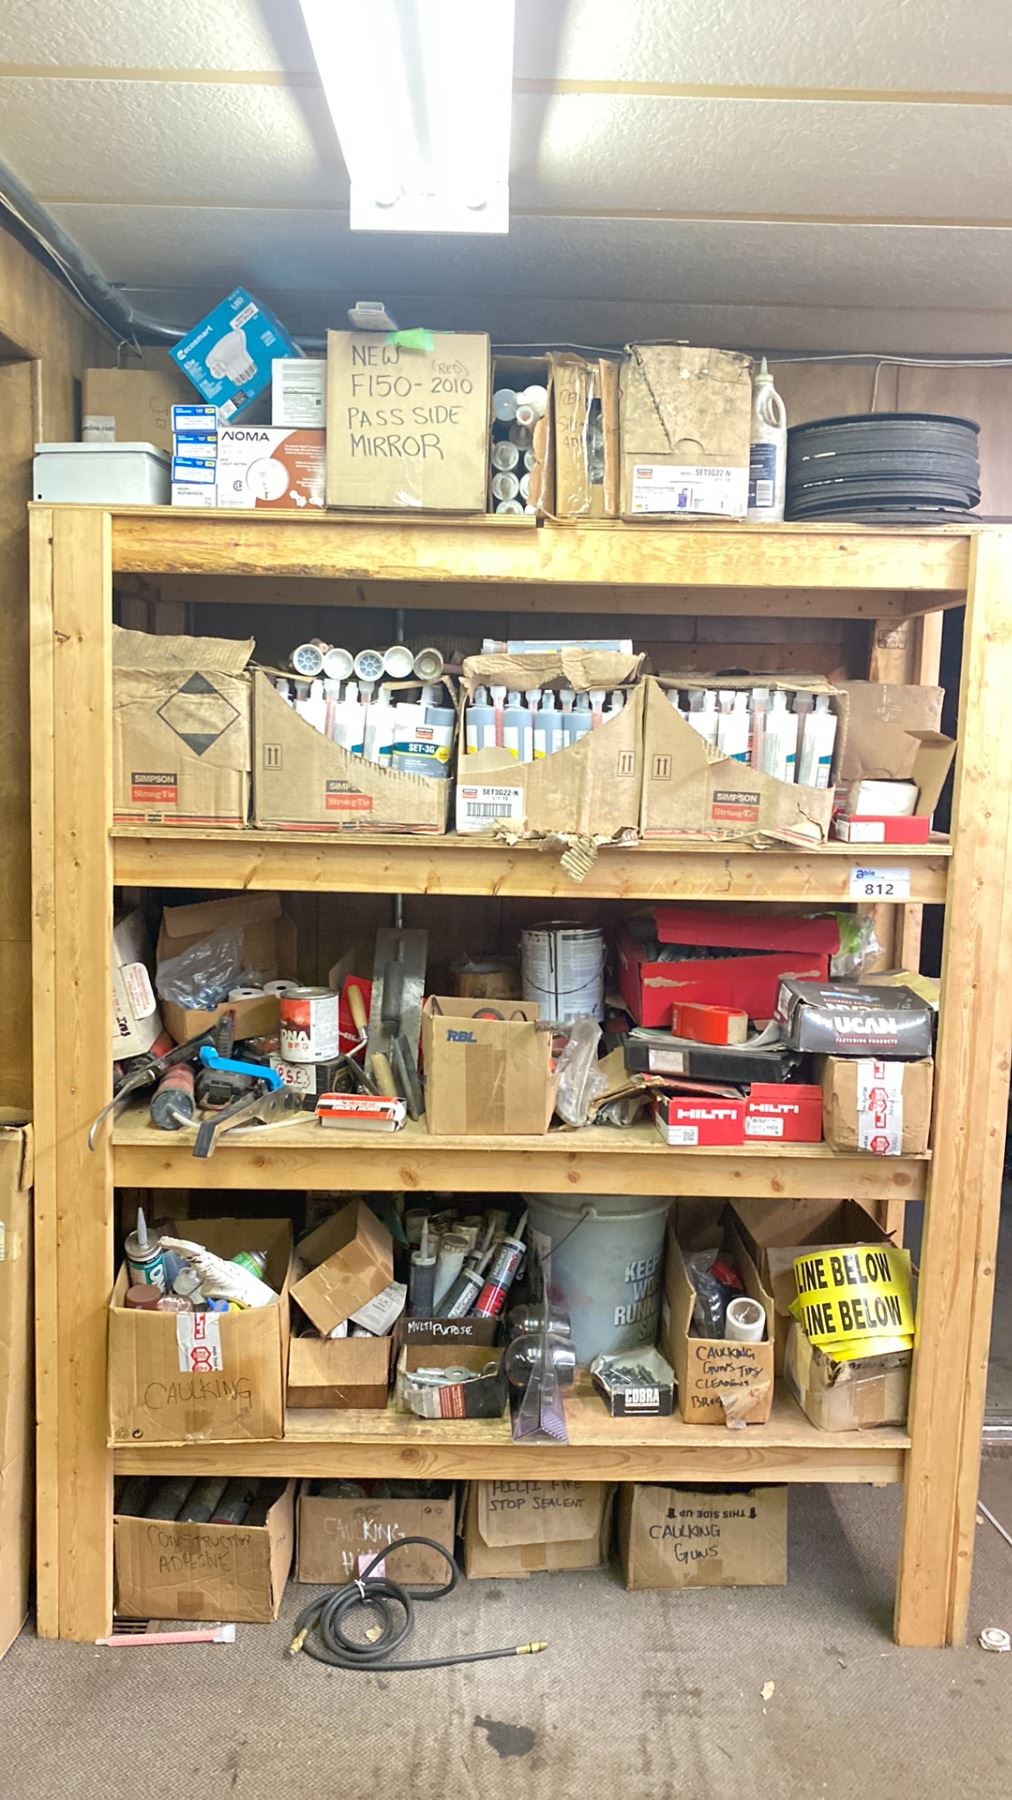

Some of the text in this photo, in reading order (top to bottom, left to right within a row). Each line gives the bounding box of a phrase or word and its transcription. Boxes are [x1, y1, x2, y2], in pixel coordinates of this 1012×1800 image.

[352, 345, 400, 366] NEW
[431, 377, 473, 394] 2010
[348, 405, 462, 429] PASS SIDE
[221, 431, 269, 442] NOMA
[350, 433, 444, 460] MIRROR
[409, 744, 435, 753] SET-3G
[134, 775, 174, 783] SIMPSON
[716, 793, 758, 802] SIMPSON
[865, 884, 894, 895] 812
[834, 1016, 898, 1034] UCAN
[677, 1109, 737, 1120] HILTI
[750, 1103, 799, 1113] HILTI
[507, 1253, 518, 1273] PRO
[830, 1253, 892, 1287] BELOW
[838, 1296, 902, 1331] BELOW
[408, 1321, 432, 1333] MULTI
[144, 1377, 253, 1410] CAULKING
[625, 1388, 660, 1403] COBRA
[490, 1498, 525, 1511] STOP
[679, 1510, 746, 1518] THIS SIDE UP
[649, 1524, 720, 1539] CAULKING
